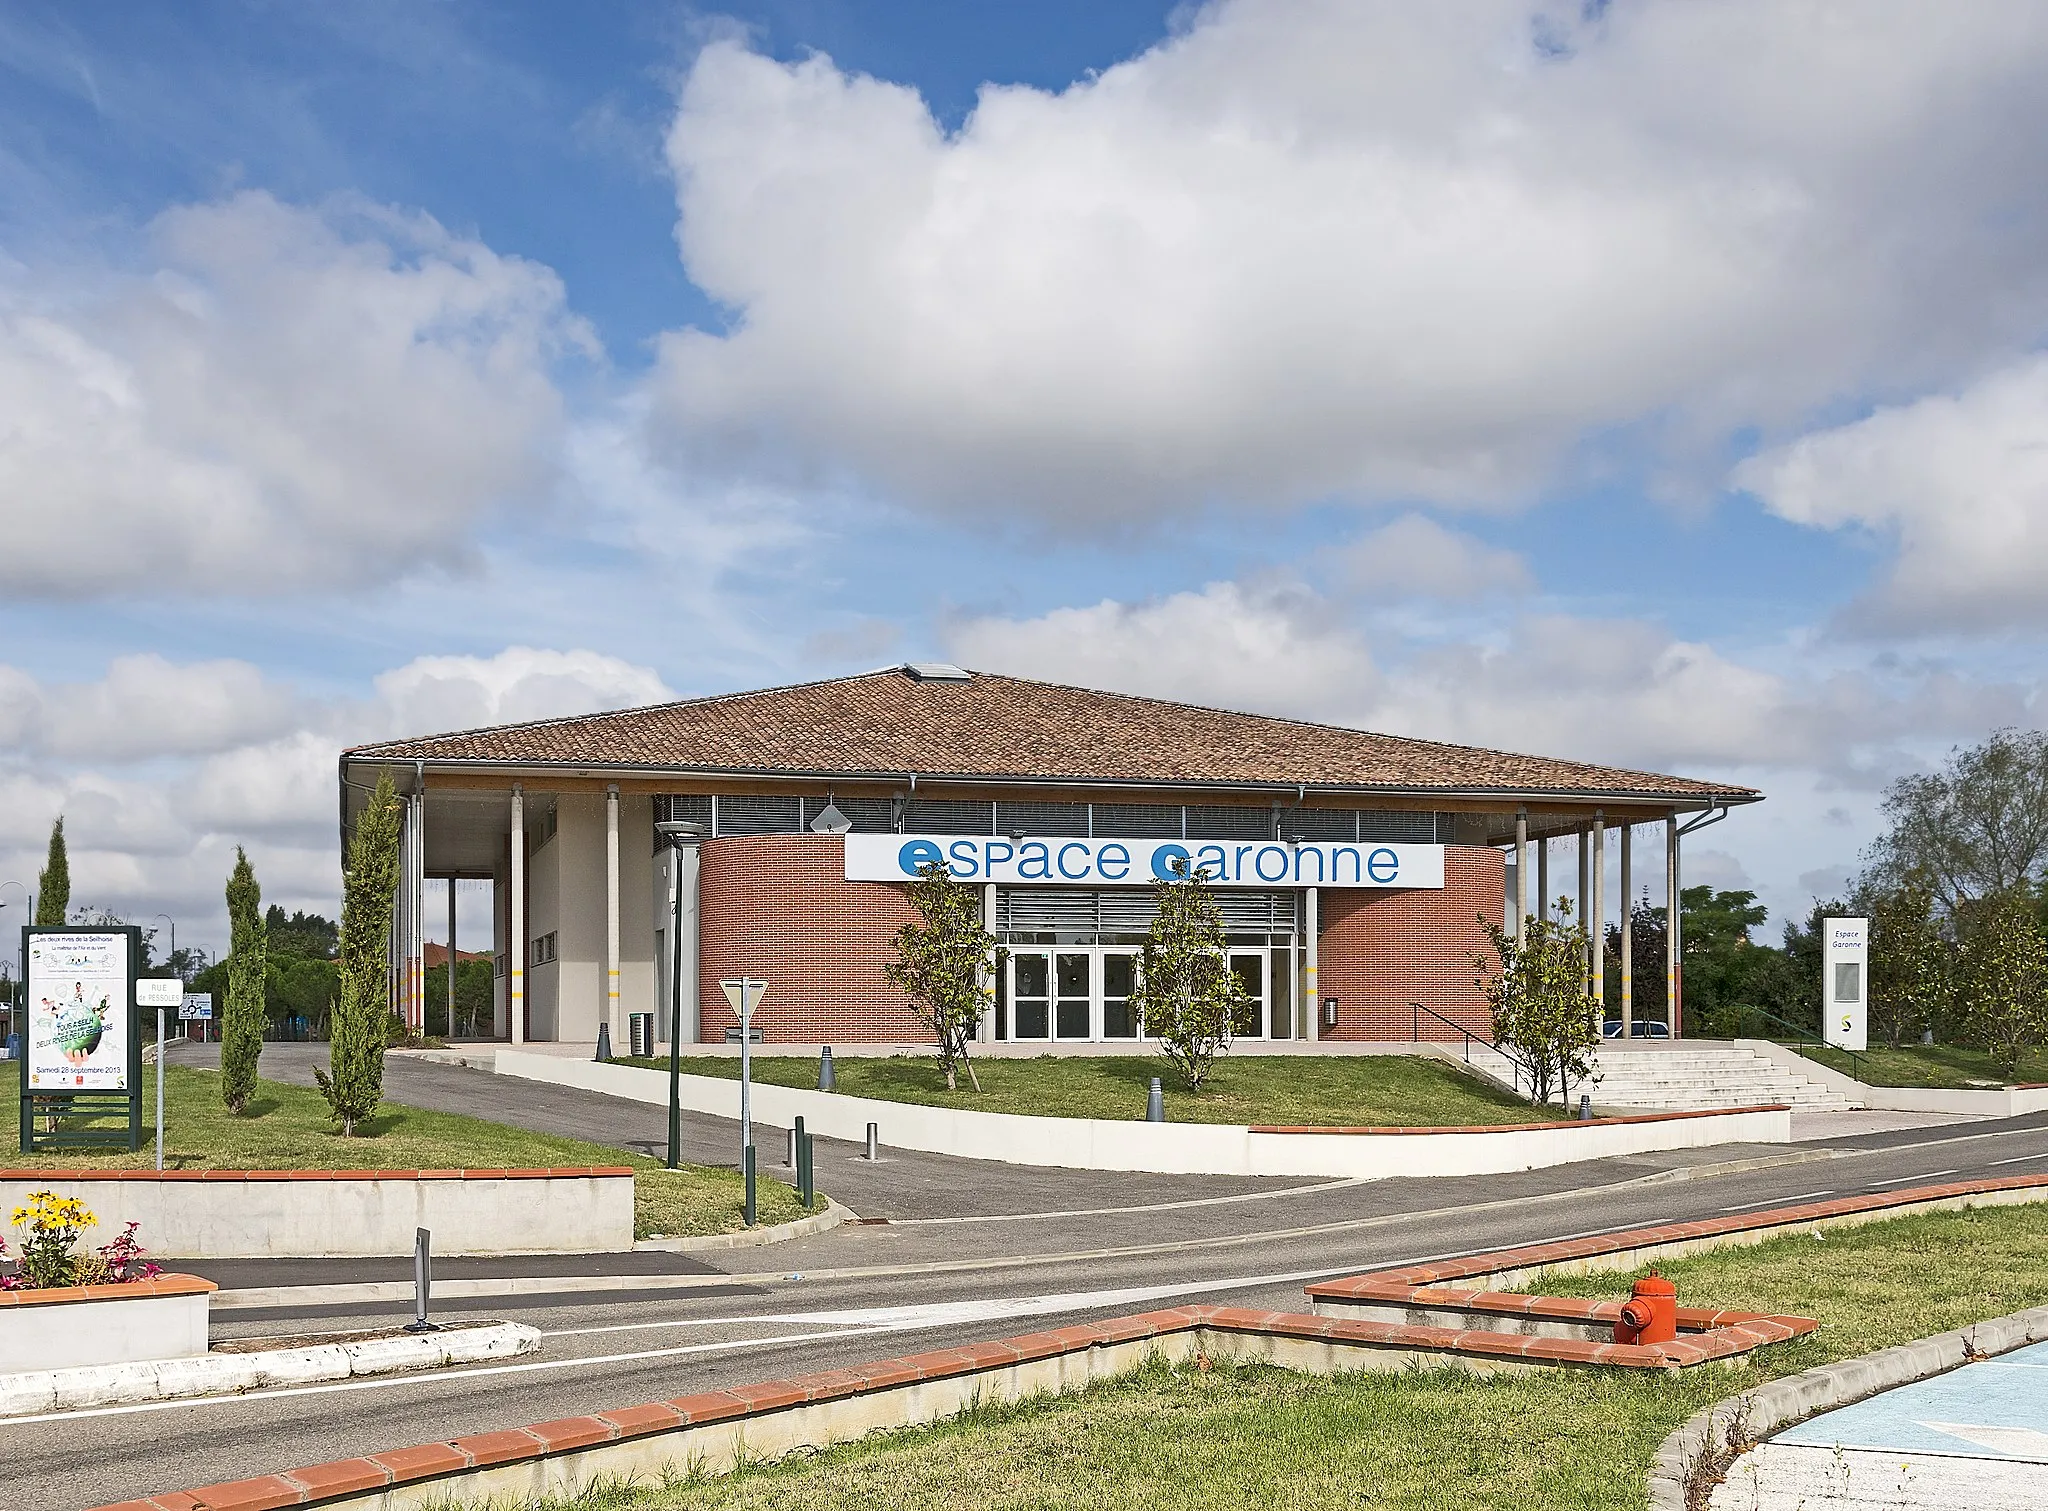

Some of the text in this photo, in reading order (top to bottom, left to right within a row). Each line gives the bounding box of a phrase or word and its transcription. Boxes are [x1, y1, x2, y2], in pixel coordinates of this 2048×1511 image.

[1835, 930, 1859, 939] Espace
[57, 1022, 72, 1033] TOUS
[77, 1017, 94, 1027] SEILH
[36, 1039, 52, 1049] DEUX
[52, 1035, 68, 1045] RIVES
[69, 1032, 77, 1041] DE
[77, 1030, 86, 1039] LA
[36, 1066, 121, 1075] Samedi 28 septembre 2013
